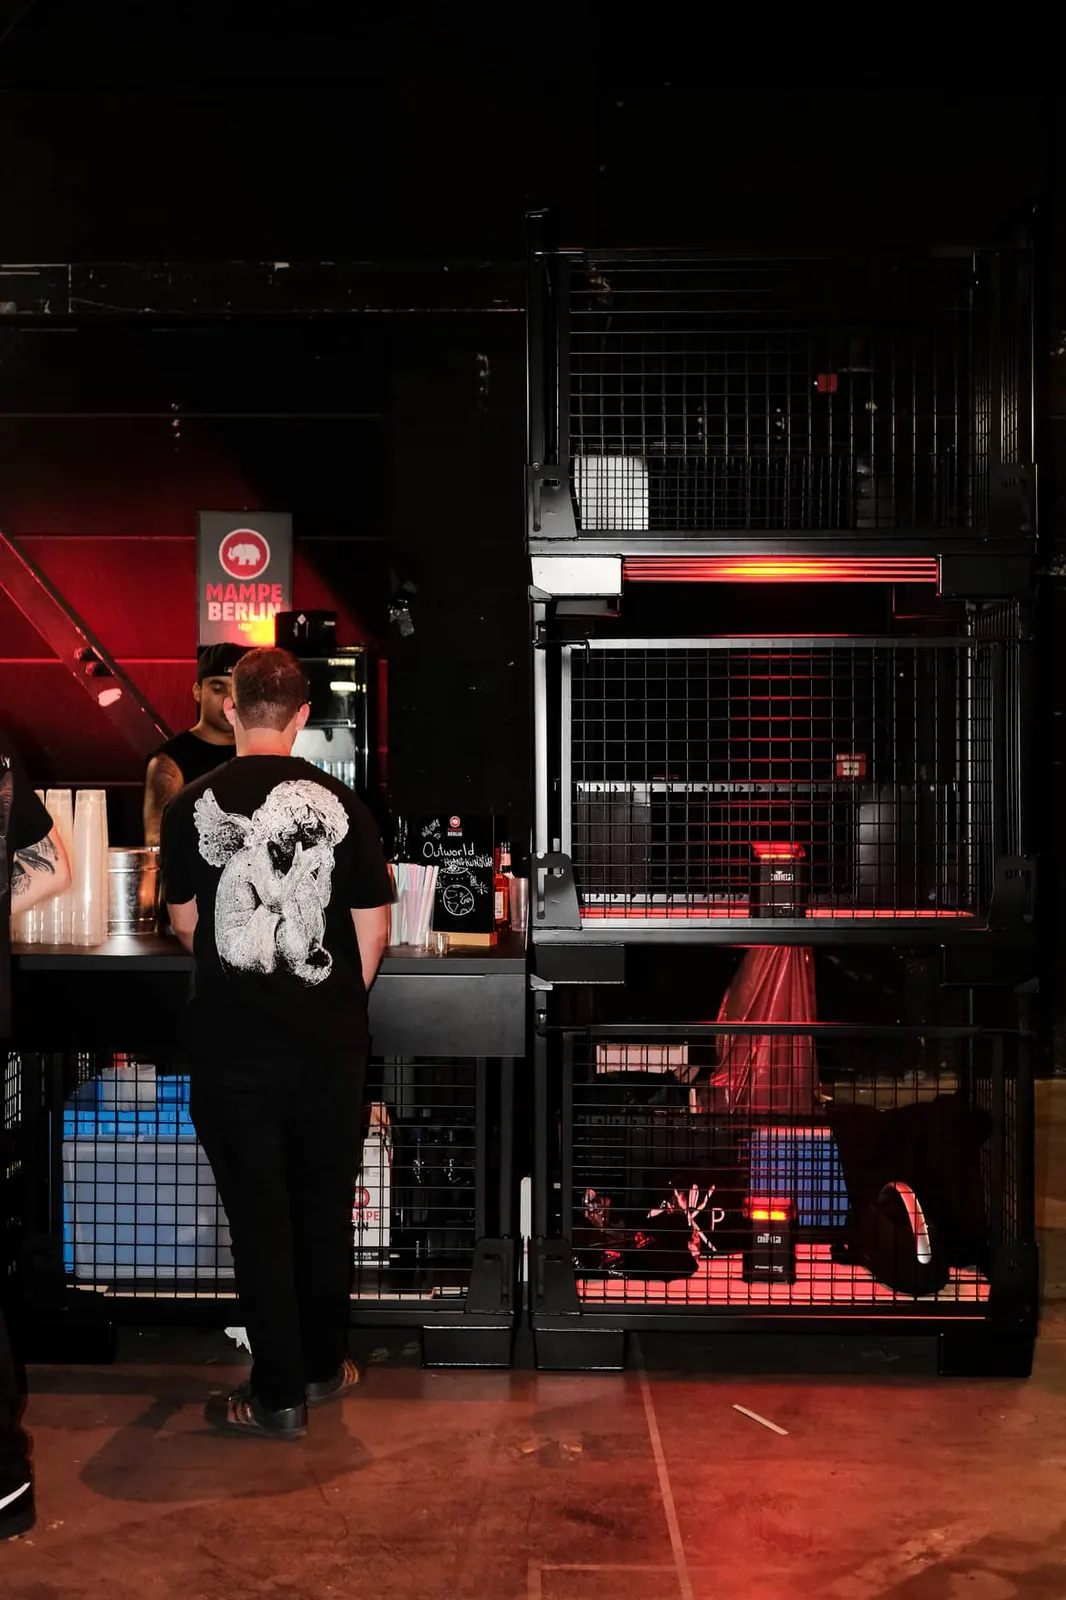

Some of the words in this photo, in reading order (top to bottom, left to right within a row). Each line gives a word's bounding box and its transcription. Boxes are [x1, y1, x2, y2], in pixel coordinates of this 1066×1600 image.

[206, 583, 283, 602] MAMPE
[208, 602, 281, 621] BERLIN
[422, 841, 475, 858] Outworld
